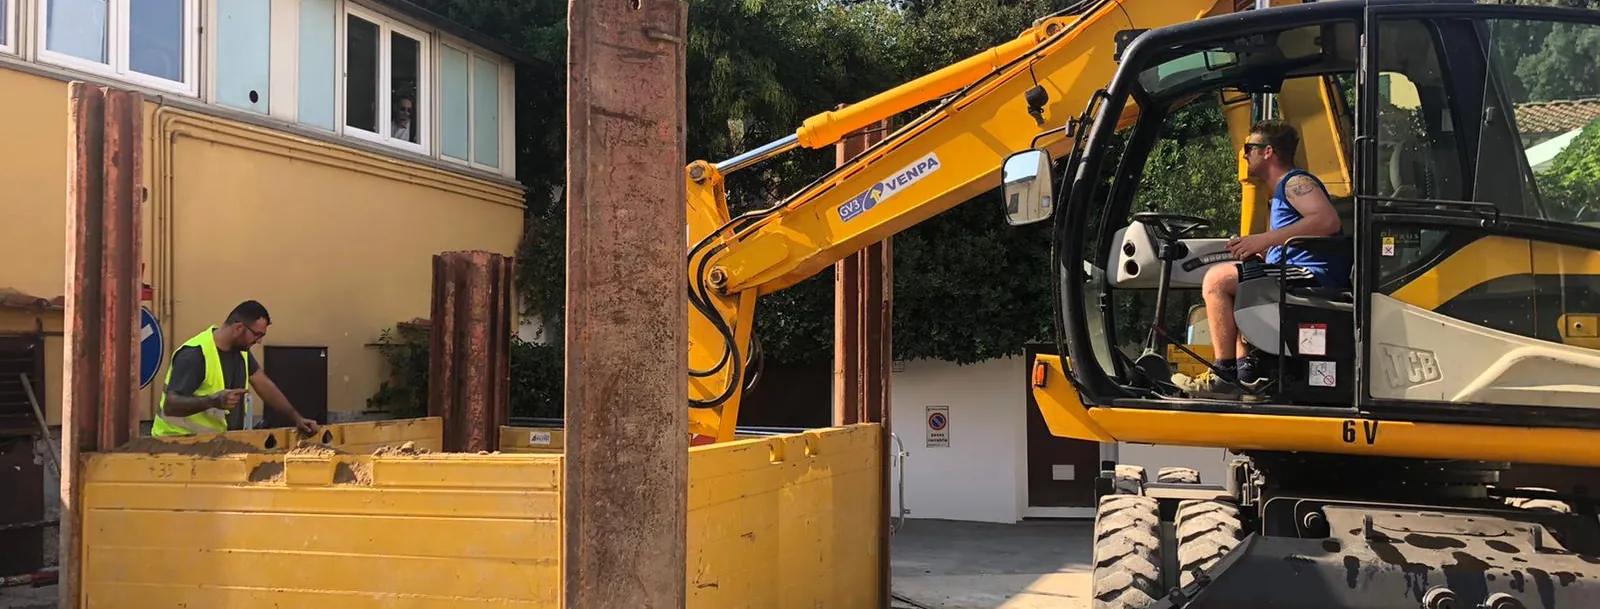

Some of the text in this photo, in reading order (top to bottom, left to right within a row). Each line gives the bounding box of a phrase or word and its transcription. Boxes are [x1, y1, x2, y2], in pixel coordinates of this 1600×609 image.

[840, 157, 938, 217] GV3 VENPA
[1382, 347, 1440, 389] JCB
[1342, 420, 1378, 445] 6 V
